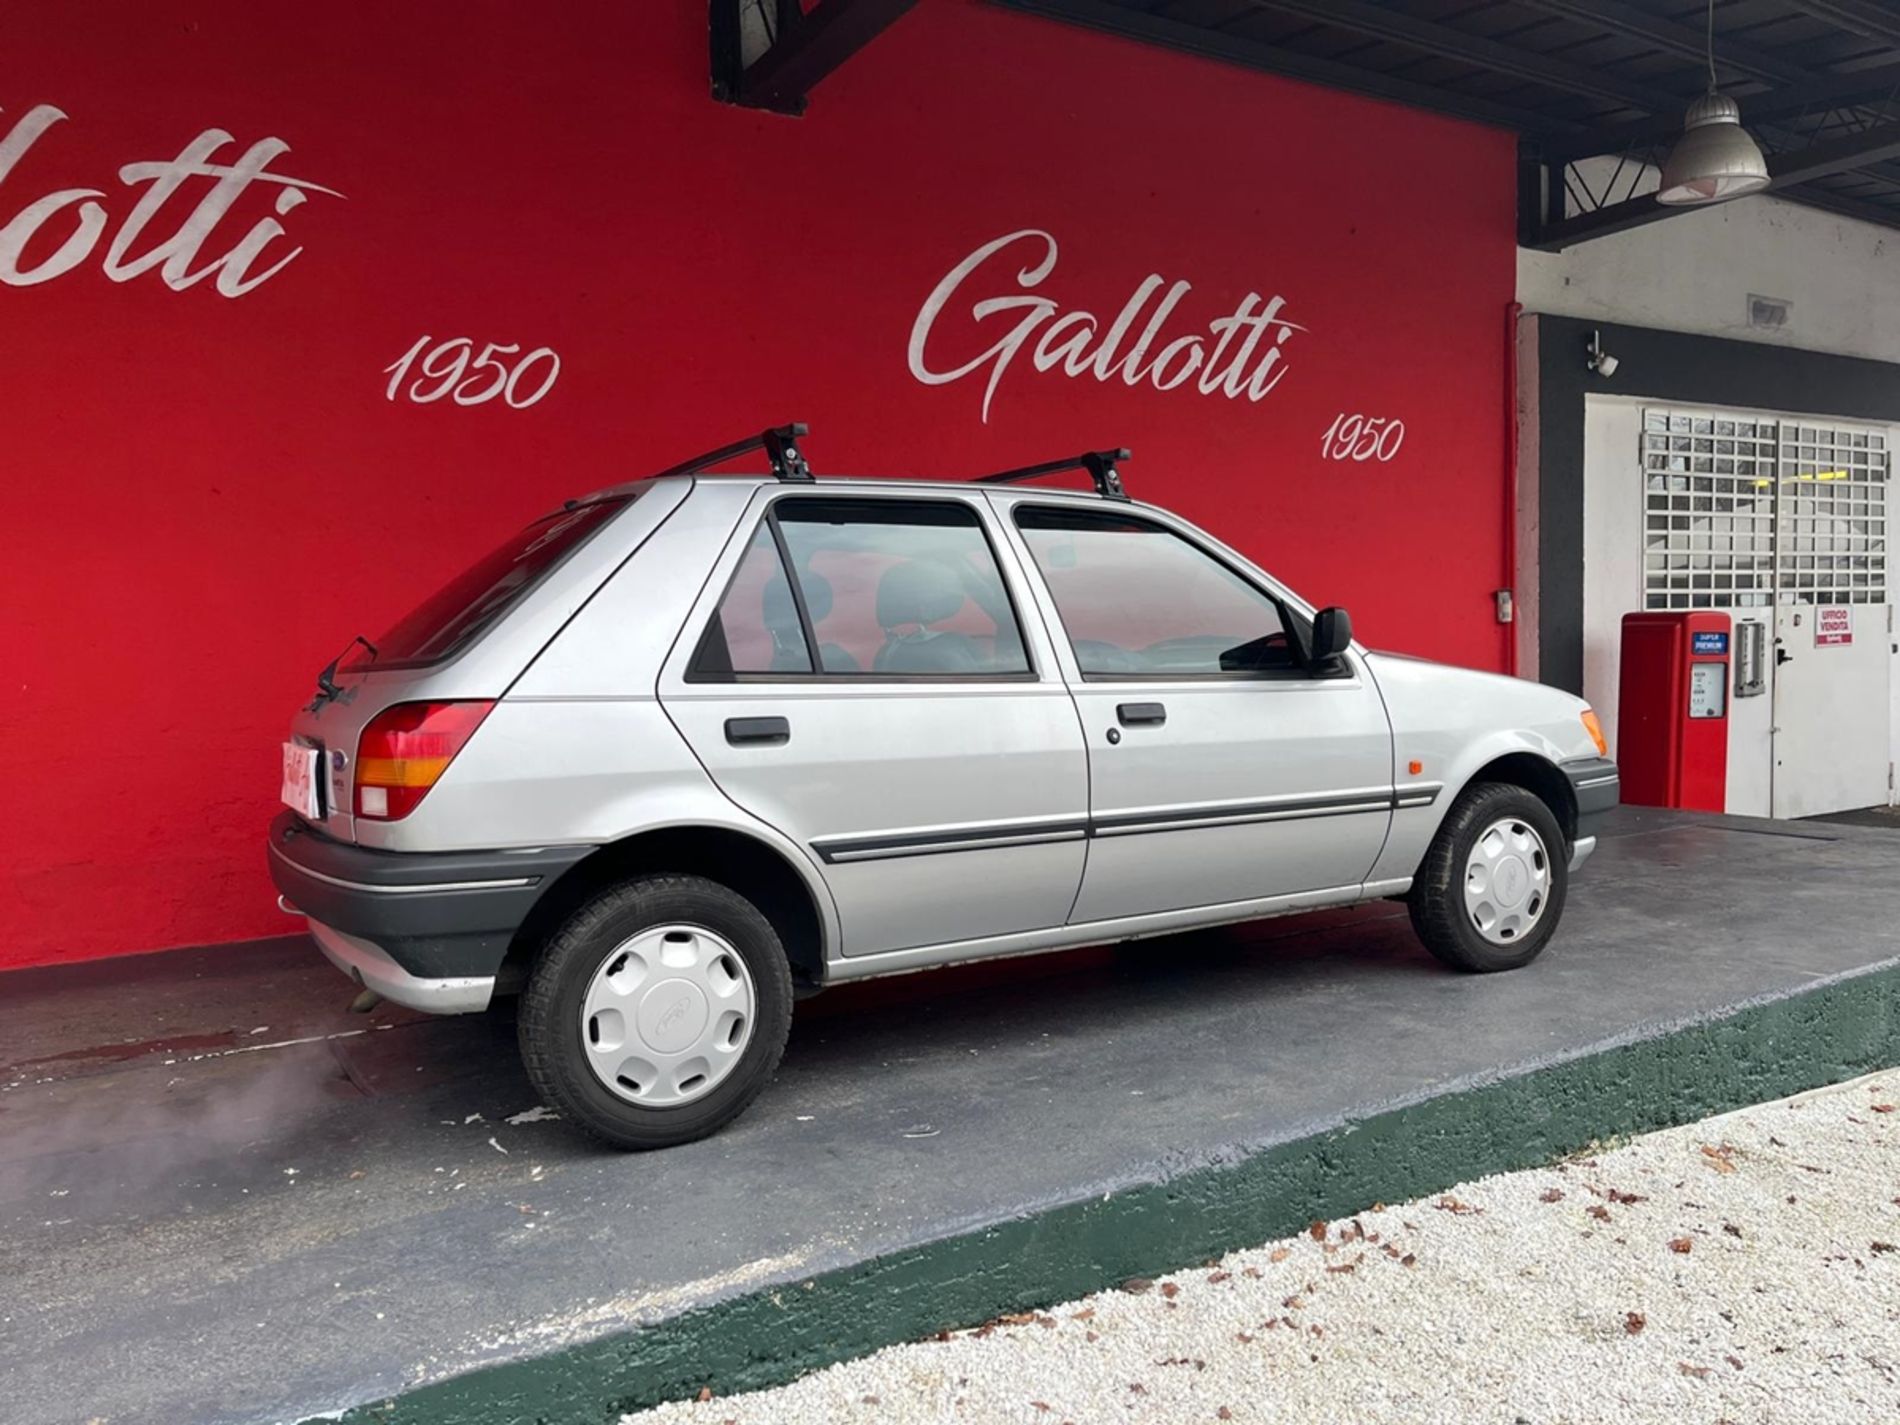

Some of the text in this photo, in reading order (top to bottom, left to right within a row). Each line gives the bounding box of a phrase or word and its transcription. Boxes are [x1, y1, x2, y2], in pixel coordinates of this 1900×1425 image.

[908, 229, 1308, 424] Gallotti
[384, 335, 561, 409] 1950
[1321, 413, 1405, 462] 1950
[1820, 621, 1849, 631] VENDITA
